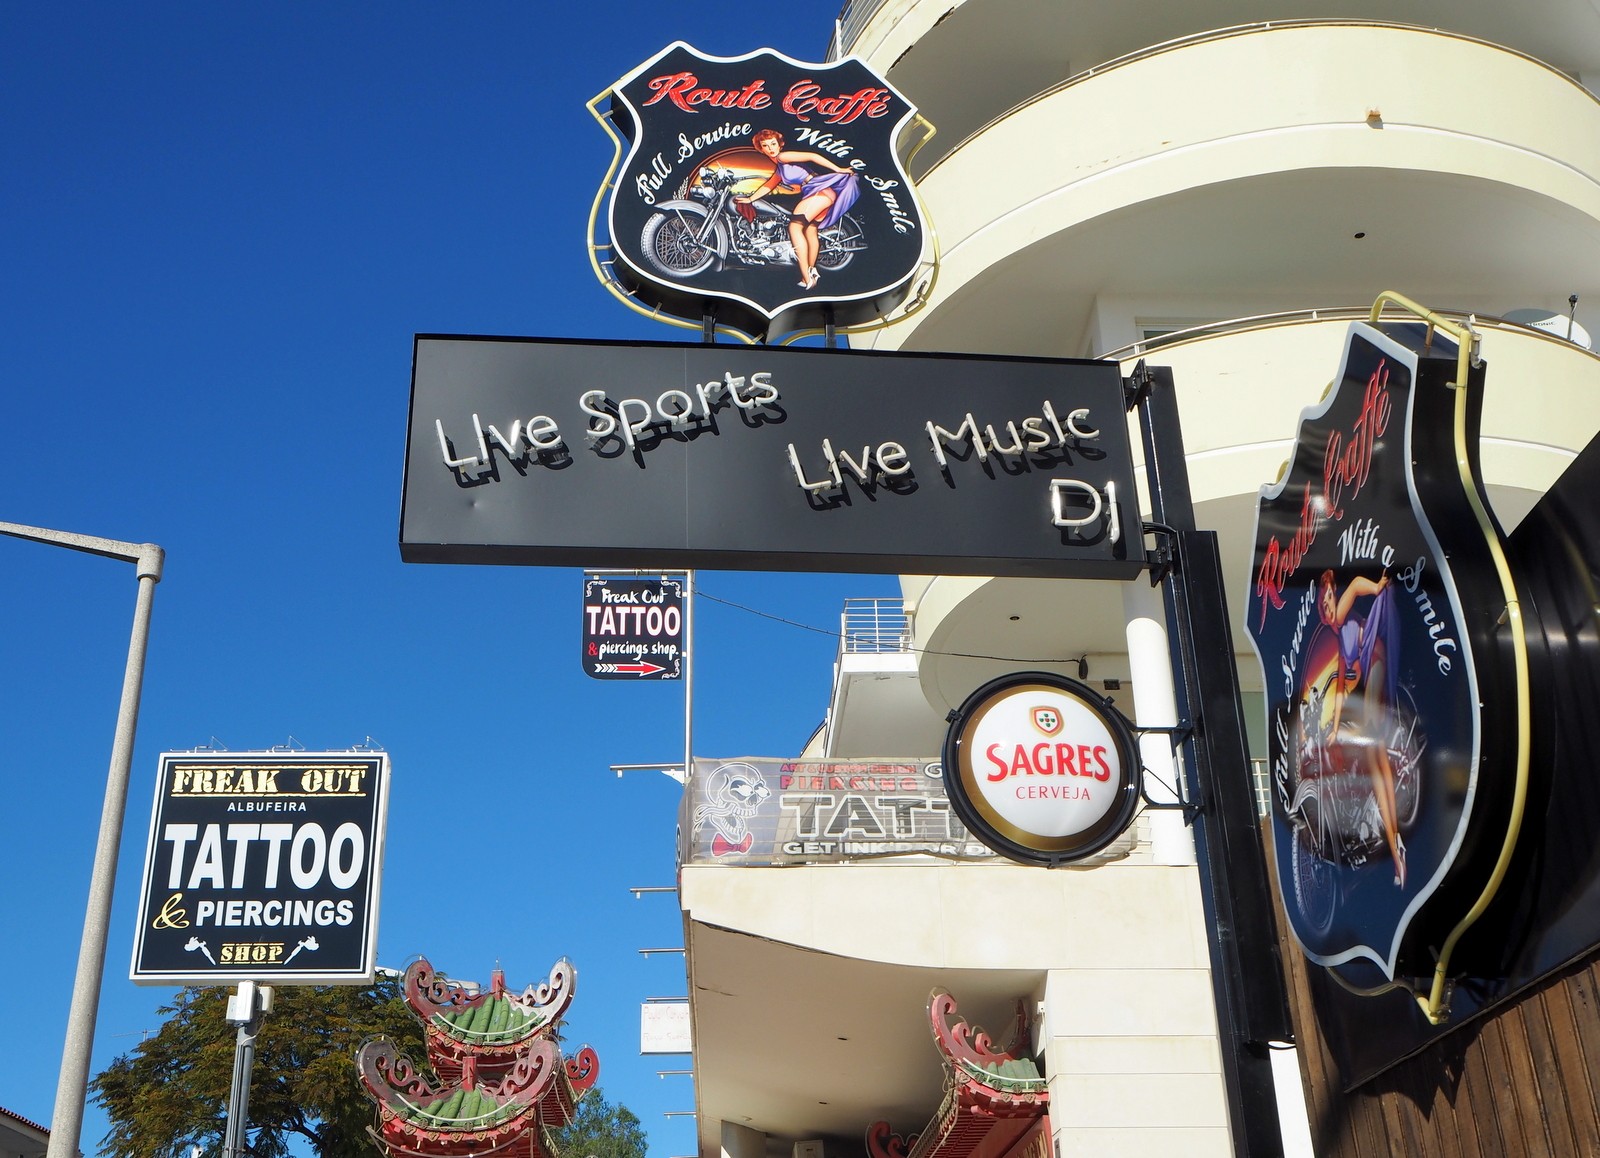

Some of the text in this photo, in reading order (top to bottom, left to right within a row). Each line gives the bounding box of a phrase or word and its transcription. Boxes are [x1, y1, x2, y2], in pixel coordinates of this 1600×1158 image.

[642, 71, 892, 125] Route Caffé
[636, 122, 916, 235] Full Service With a Smile
[579, 371, 779, 450] Sports
[1050, 478, 1120, 545] DJ
[1256, 358, 1392, 635] Route Caffé
[601, 587, 668, 604] Freak Out
[586, 606, 681, 636] TATTOO
[588, 642, 598, 656] &
[598, 641, 648, 661] piercings
[1274, 518, 1457, 814] Full Service With a Smile
[780, 763, 803, 773] ART
[986, 742, 1111, 783] SAGRES
[171, 769, 366, 793] FREAK OUT
[780, 776, 919, 791] PIERCING
[1015, 786, 1091, 801] CERVEJA
[227, 802, 307, 812] ALBUFEIRA
[779, 794, 968, 842] TATT
[164, 822, 365, 890] TATTOO
[783, 842, 837, 855] GET
[152, 893, 354, 930] & PIERCINGS
[220, 944, 284, 962] SHOP
